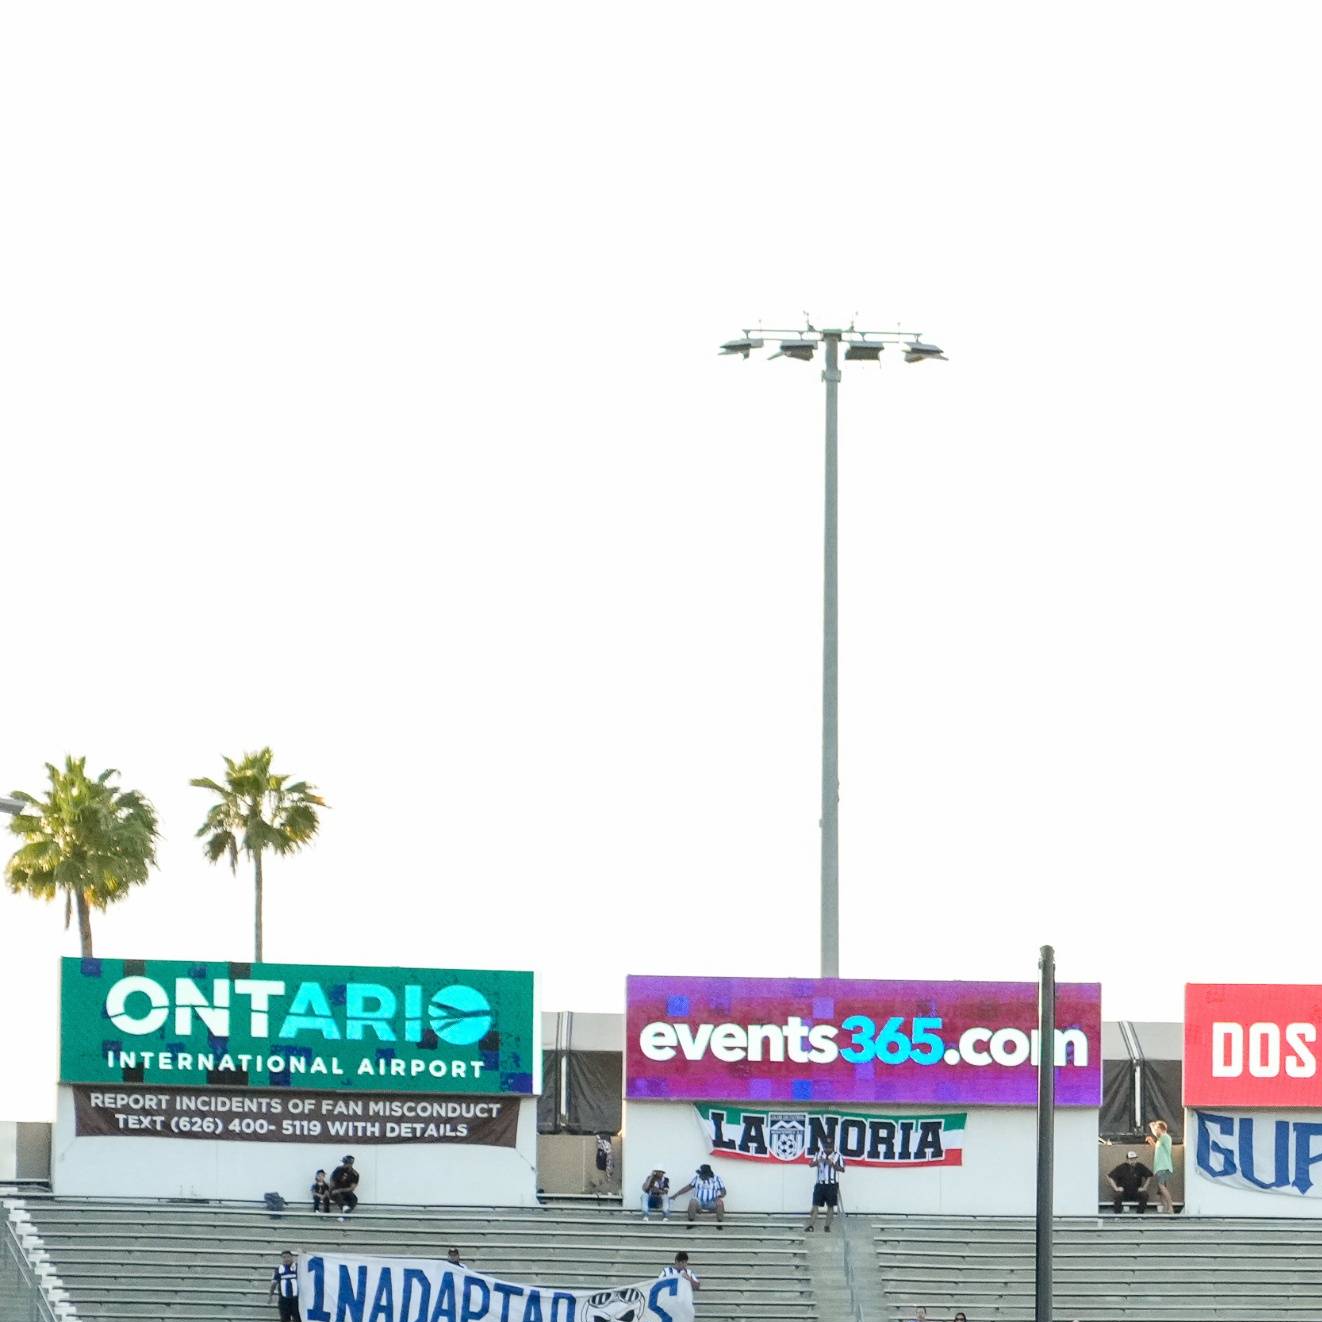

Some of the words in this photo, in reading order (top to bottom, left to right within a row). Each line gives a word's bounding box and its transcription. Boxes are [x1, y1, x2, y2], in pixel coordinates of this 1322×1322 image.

[105, 976, 492, 1046] ONTARIO
[106, 1051, 344, 1075] INTERNATIONAL
[358, 1057, 486, 1079] AIRPORT
[640, 1015, 1088, 1067] events365.com
[1212, 1021, 1316, 1079] DOS
[90, 1093, 169, 1110] REPORT
[175, 1096, 282, 1113] INCIDENTS
[288, 1100, 316, 1115] OF
[321, 1100, 363, 1116] FAN
[369, 1102, 501, 1118] MISCONDUCT
[115, 1113, 165, 1130] TEXT
[170, 1115, 224, 1135] (626)
[228, 1118, 276, 1134] 400-
[282, 1119, 321, 1136] 5119
[326, 1120, 380, 1137] WITH
[385, 1122, 468, 1138] DETAILS
[709, 1110, 770, 1158] LA
[804, 1114, 946, 1161] NORIA
